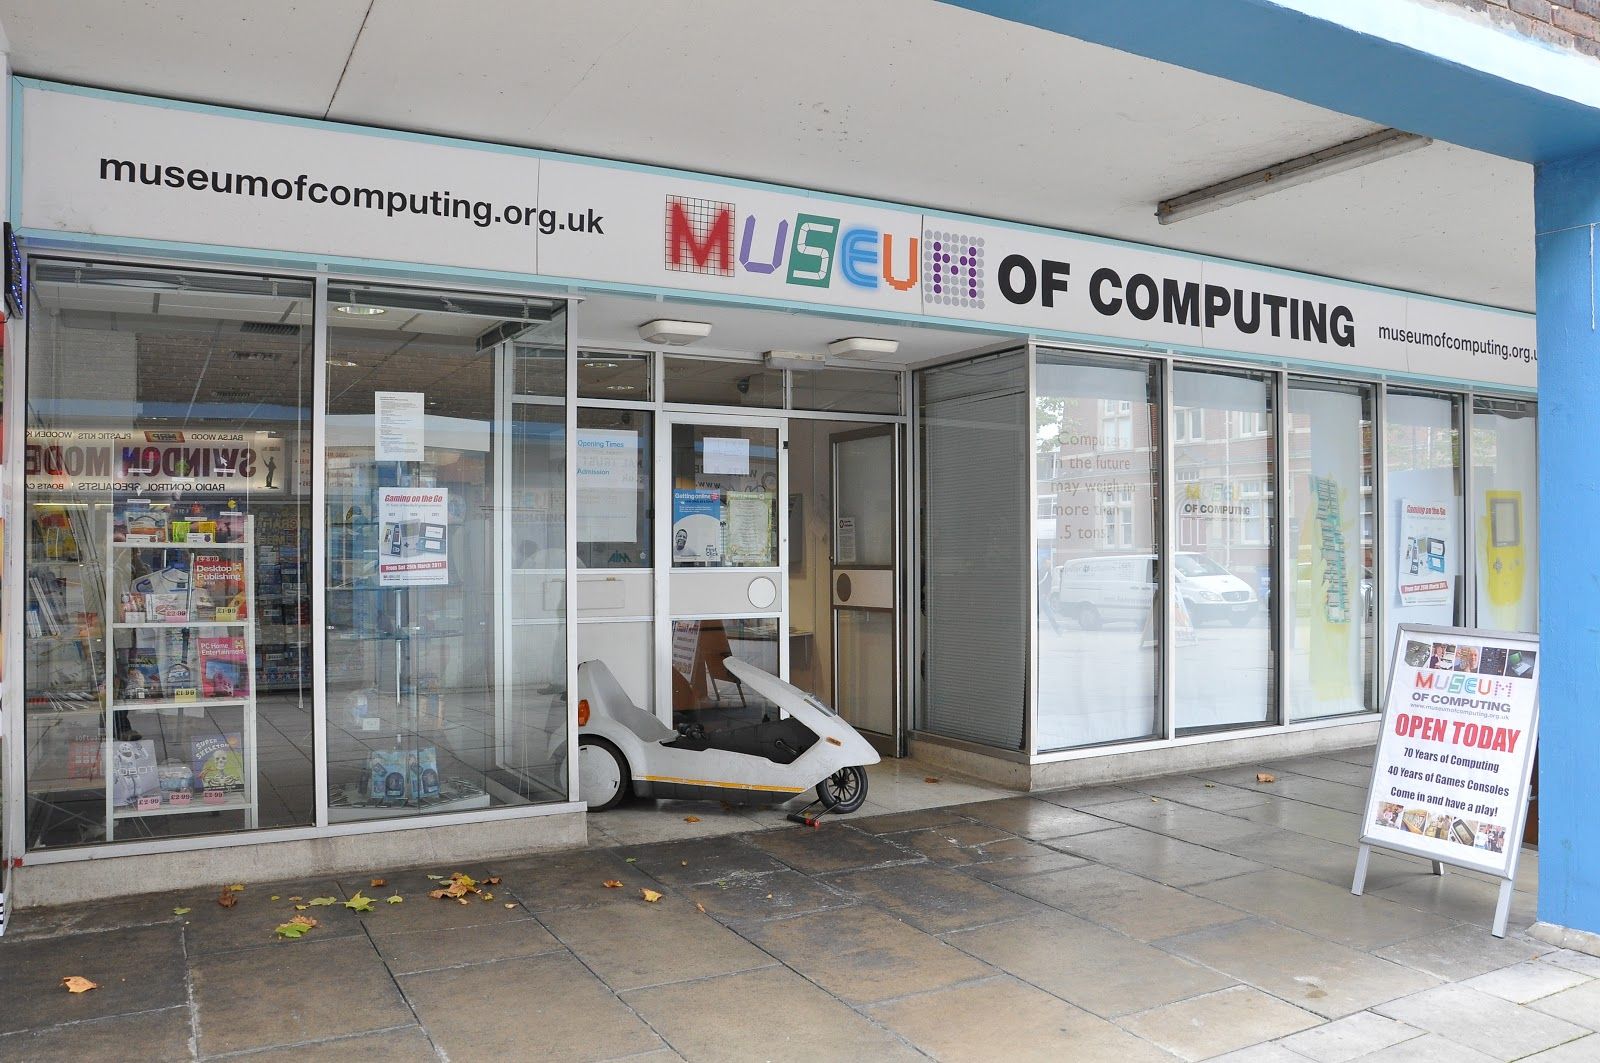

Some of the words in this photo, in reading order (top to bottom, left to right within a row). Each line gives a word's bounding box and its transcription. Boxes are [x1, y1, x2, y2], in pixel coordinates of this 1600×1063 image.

[99, 156, 605, 236] museumofcomputing.org.uk
[664, 192, 986, 310] MUSEUM
[997, 253, 1071, 308] OF
[1088, 267, 1356, 348] COMPUTING
[577, 440, 605, 448] Opening
[605, 440, 624, 448] Times
[1070, 455, 1092, 469] the
[1096, 455, 1131, 470] future
[1051, 482, 1080, 497] may
[1085, 480, 1119, 497] weigh
[385, 495, 411, 503] Gaming
[412, 495, 421, 503] on
[422, 495, 433, 503] the
[434, 495, 443, 503] Go
[1184, 503, 1198, 513] OF
[1053, 505, 1089, 516] more
[196, 565, 232, 573] Desktop
[197, 573, 241, 581] Publishing
[1415, 671, 1513, 698] MUSEUM
[1410, 702, 1510, 720] www.museumofcomputing.org.uk
[1411, 691, 1430, 702] OF
[1430, 694, 1511, 713] COMPUTING
[1395, 713, 1448, 742] OPEN
[1452, 720, 1521, 753] TODAY
[1403, 747, 1414, 758] 70
[1415, 749, 1438, 762] Years
[1440, 753, 1450, 764] of
[1450, 755, 1500, 774] Computing
[1387, 765, 1399, 776] 40
[1400, 767, 1423, 781] Years
[1424, 772, 1434, 782] of
[1435, 773, 1465, 789] Games
[1467, 779, 1510, 797] Consoles
[1390, 786, 1415, 800] Come
[1416, 792, 1425, 802] in
[1427, 794, 1444, 806] and
[1444, 797, 1466, 810] have
[1467, 803, 1474, 812] a
[1474, 804, 1498, 817] play!
